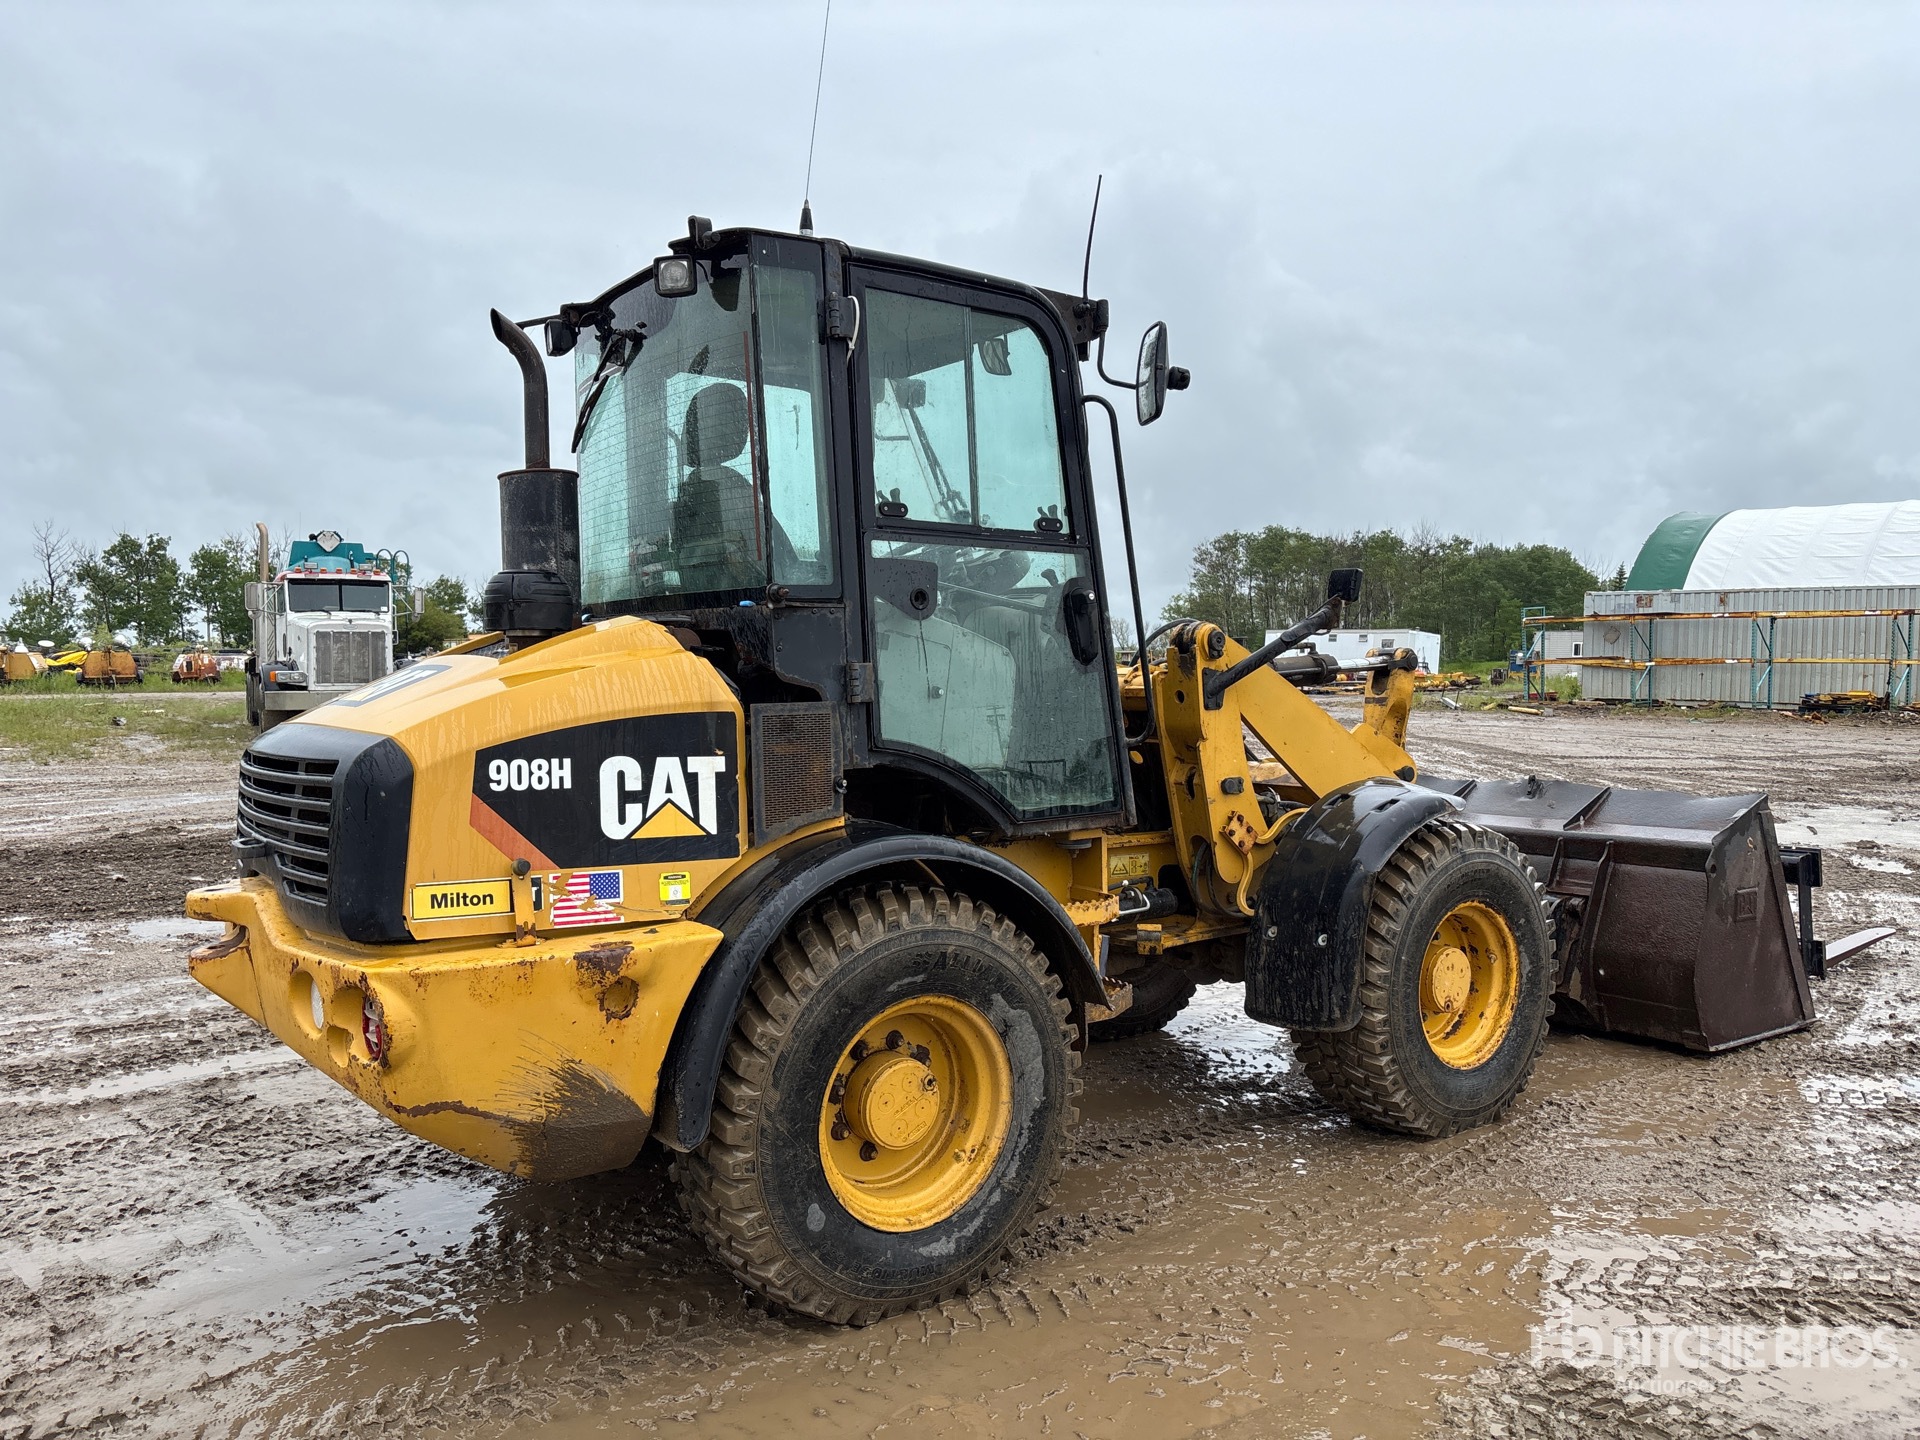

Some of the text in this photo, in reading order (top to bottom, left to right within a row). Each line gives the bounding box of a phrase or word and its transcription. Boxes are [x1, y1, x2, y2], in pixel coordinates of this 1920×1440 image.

[488, 757, 572, 792] 908H
[599, 755, 726, 840] CAT
[430, 892, 494, 910] Milton
